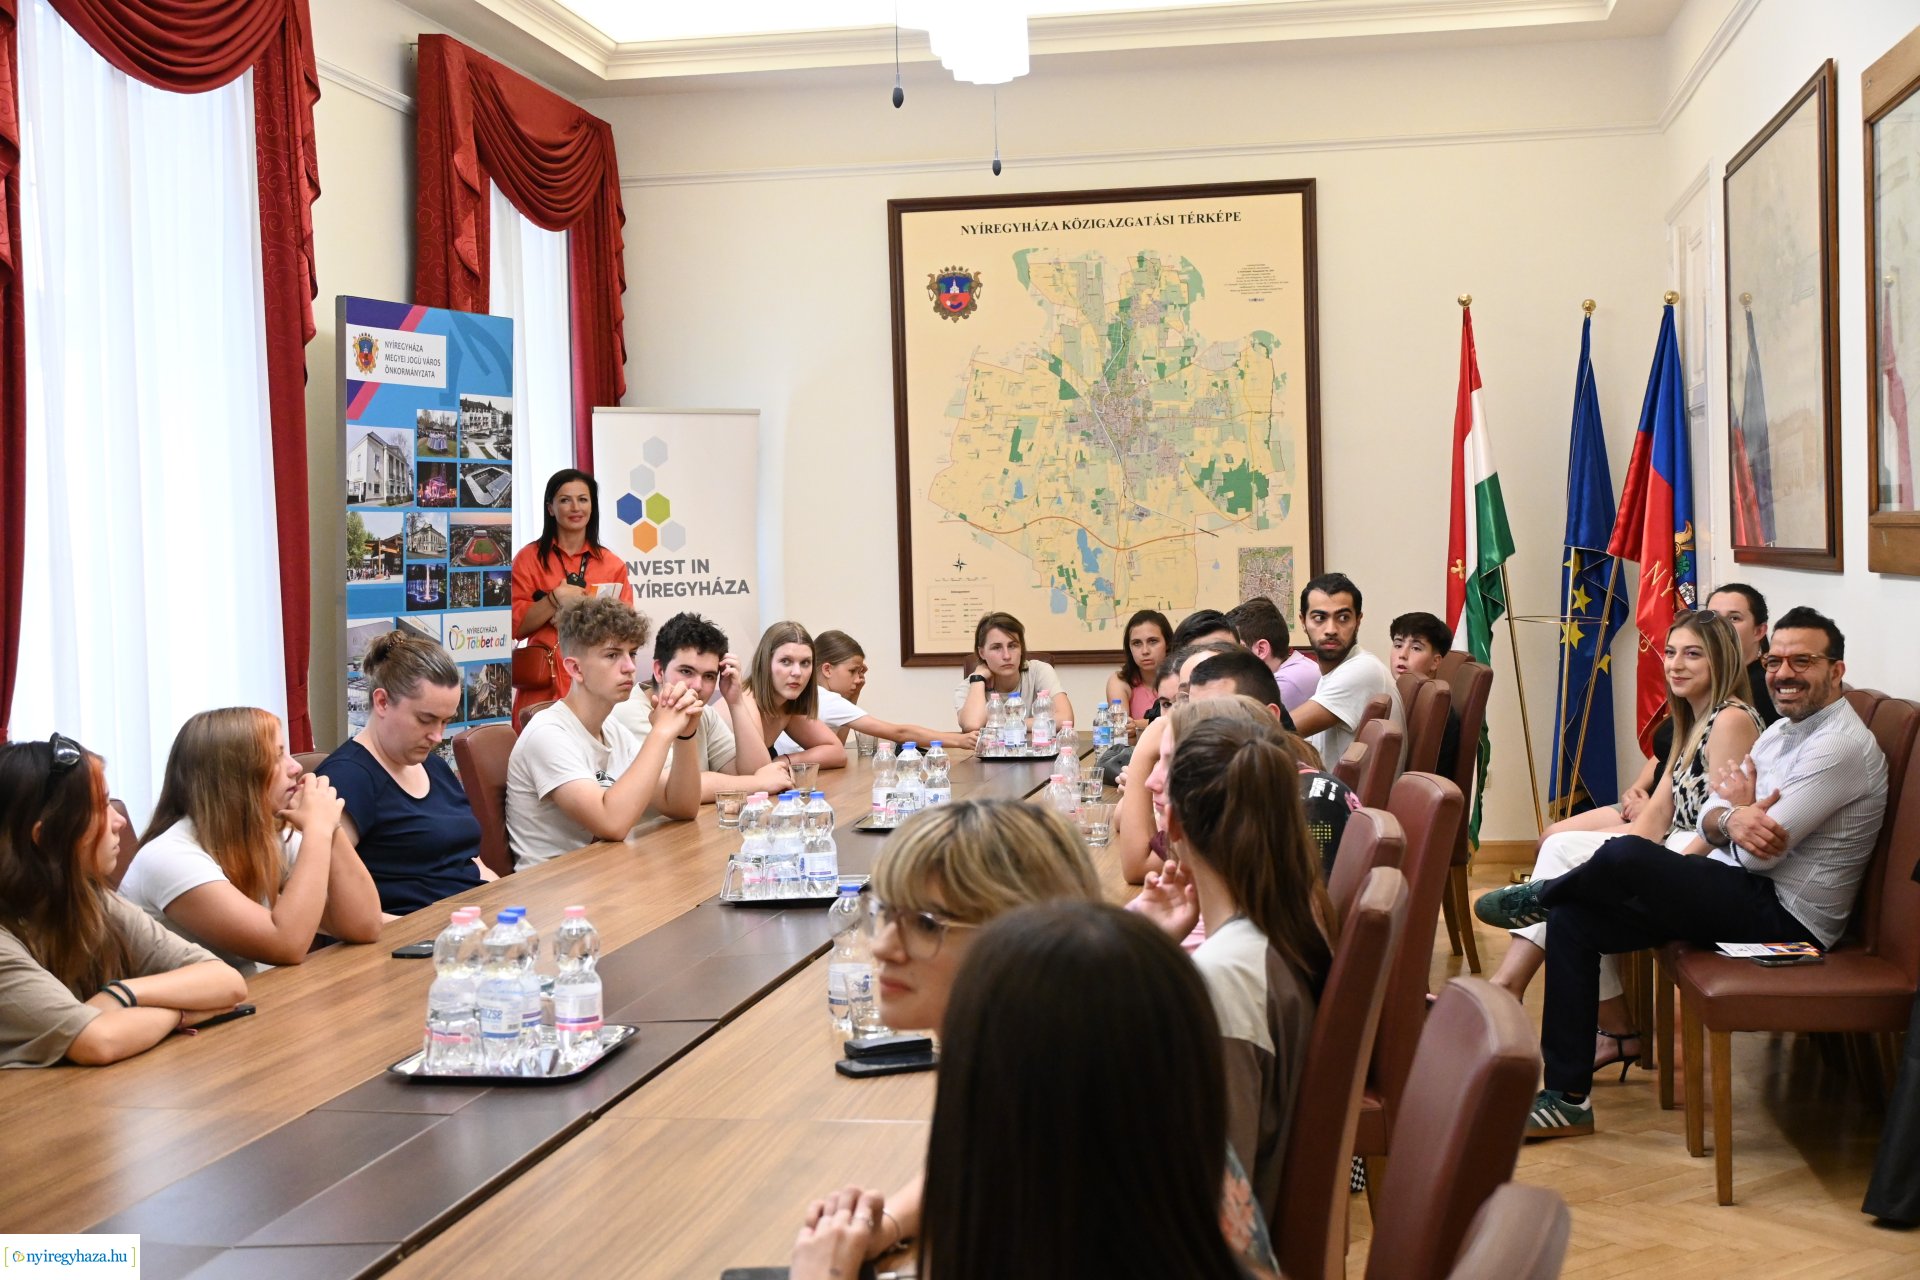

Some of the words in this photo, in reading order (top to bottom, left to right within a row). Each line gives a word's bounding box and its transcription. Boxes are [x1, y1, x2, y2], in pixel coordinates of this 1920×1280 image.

[960, 219, 1059, 236] NYÍREGYHÁZA
[1062, 212, 1175, 231] KÖZIGAZGATÁSI
[1178, 210, 1242, 225] TÉRKÉPE
[384, 340, 424, 353] NYÍREGYHÁZA
[384, 354, 406, 363] MEGYEI
[422, 357, 441, 367] VÁROS
[384, 365, 435, 378] ÖNKORMÁNYZATA
[625, 560, 686, 577] NVEST
[691, 558, 710, 574] IN
[466, 625, 498, 635] NYÍREGYHÁZA
[466, 635, 494, 650] Többet
